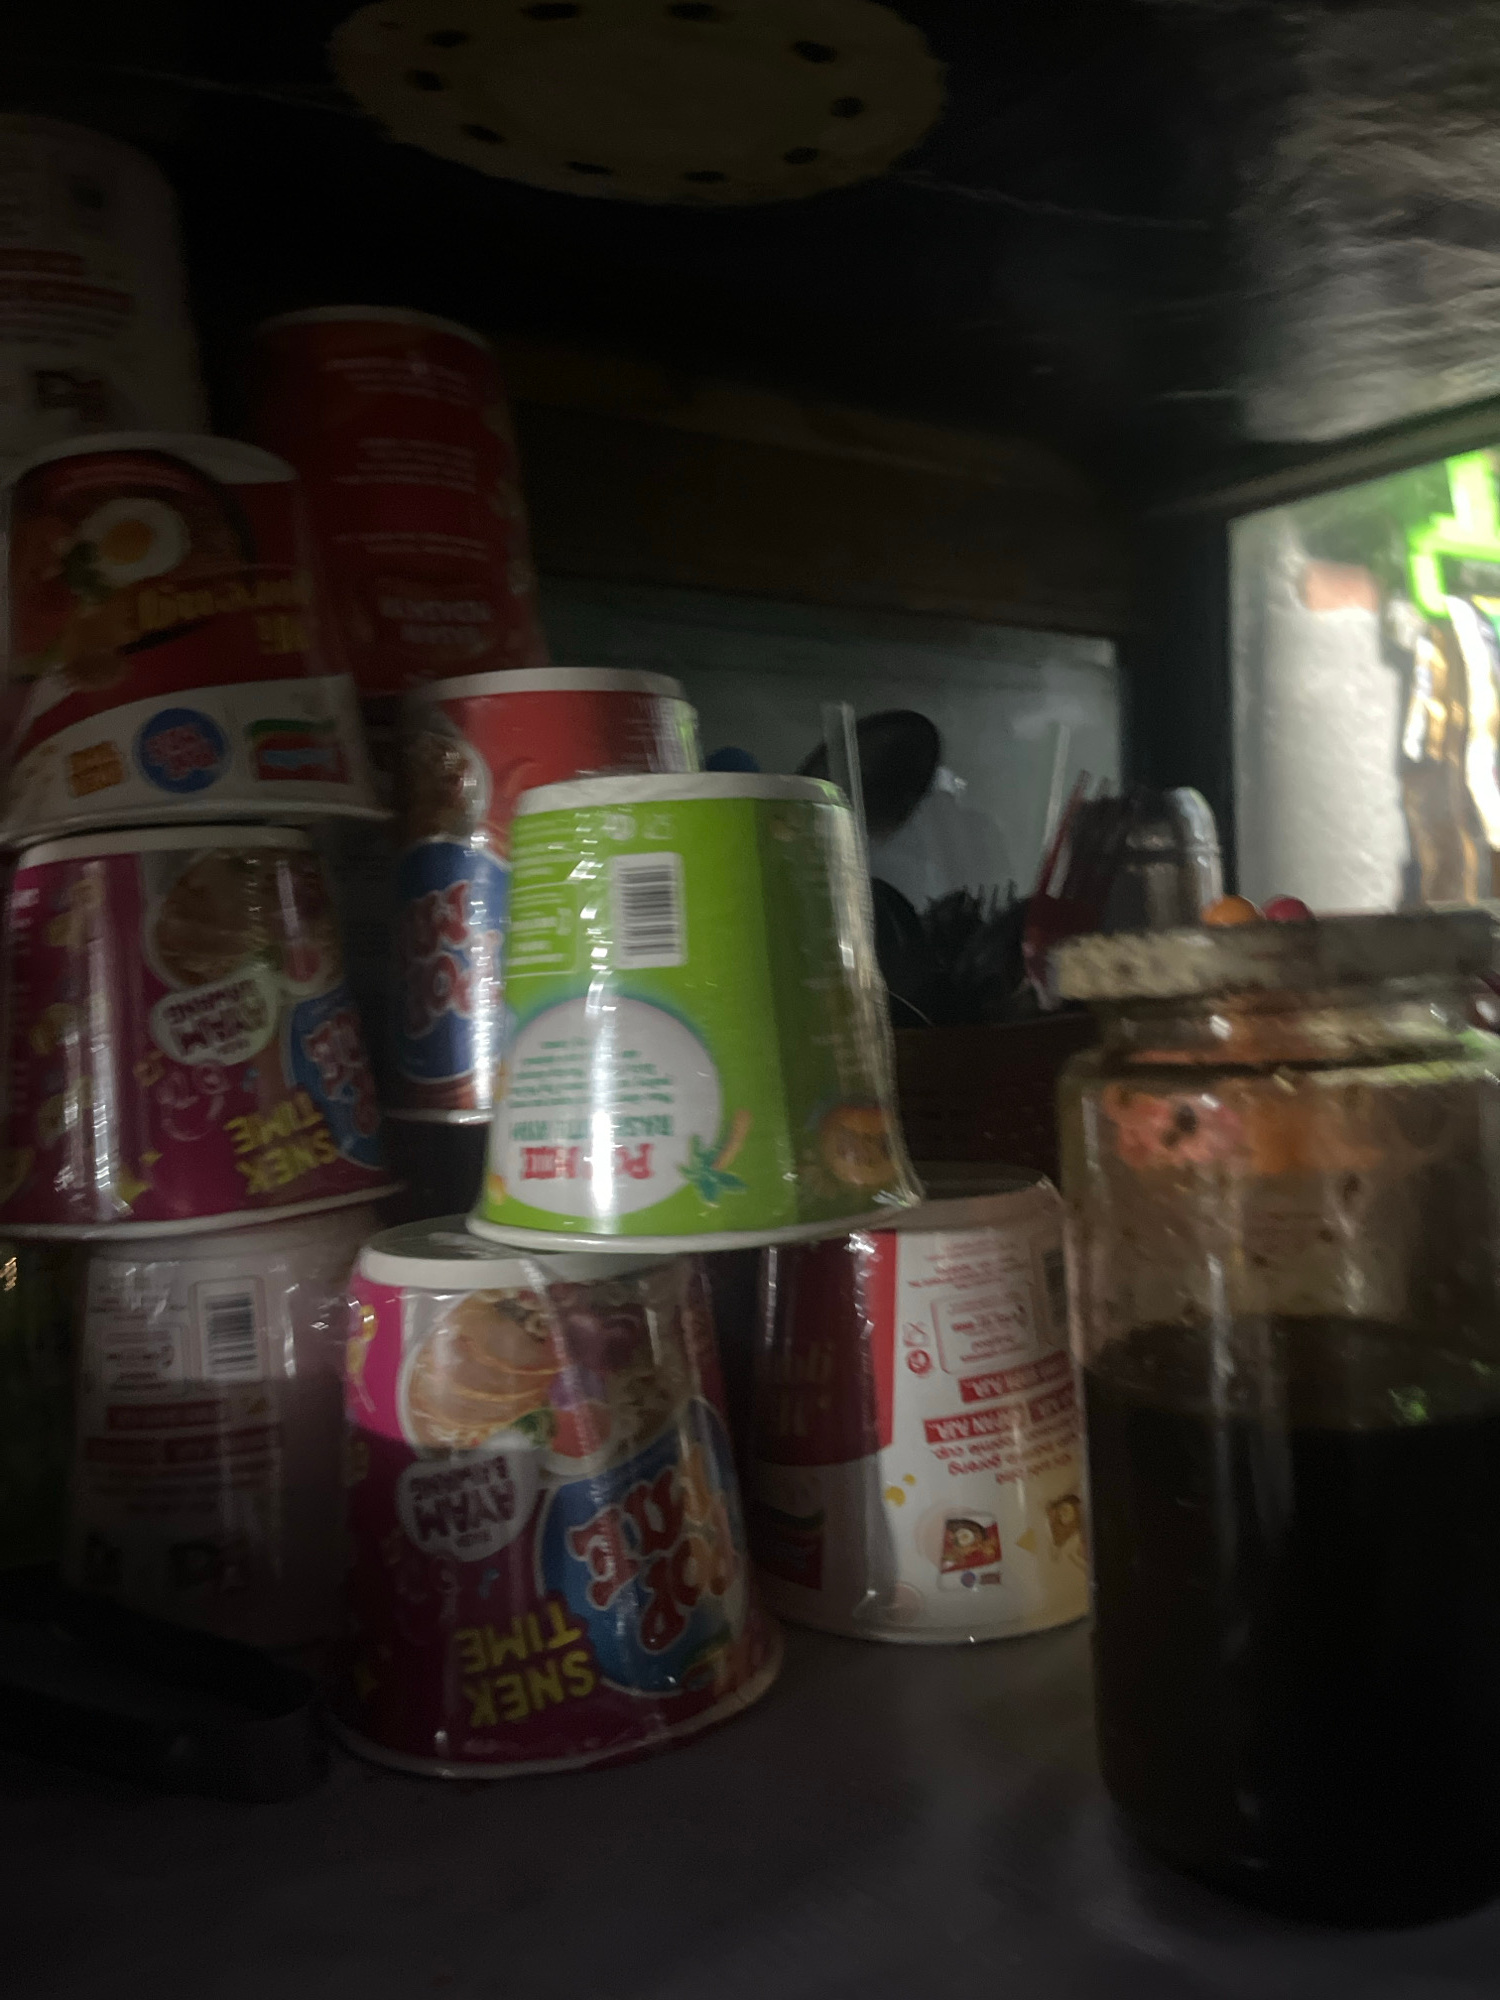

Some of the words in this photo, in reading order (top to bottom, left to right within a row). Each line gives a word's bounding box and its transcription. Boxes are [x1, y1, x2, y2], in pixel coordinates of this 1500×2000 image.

[223, 1092, 323, 1154] TIME
[235, 1129, 338, 1194] SNEK
[453, 1601, 582, 1673] TIME
[459, 1648, 596, 1728] SNEK
